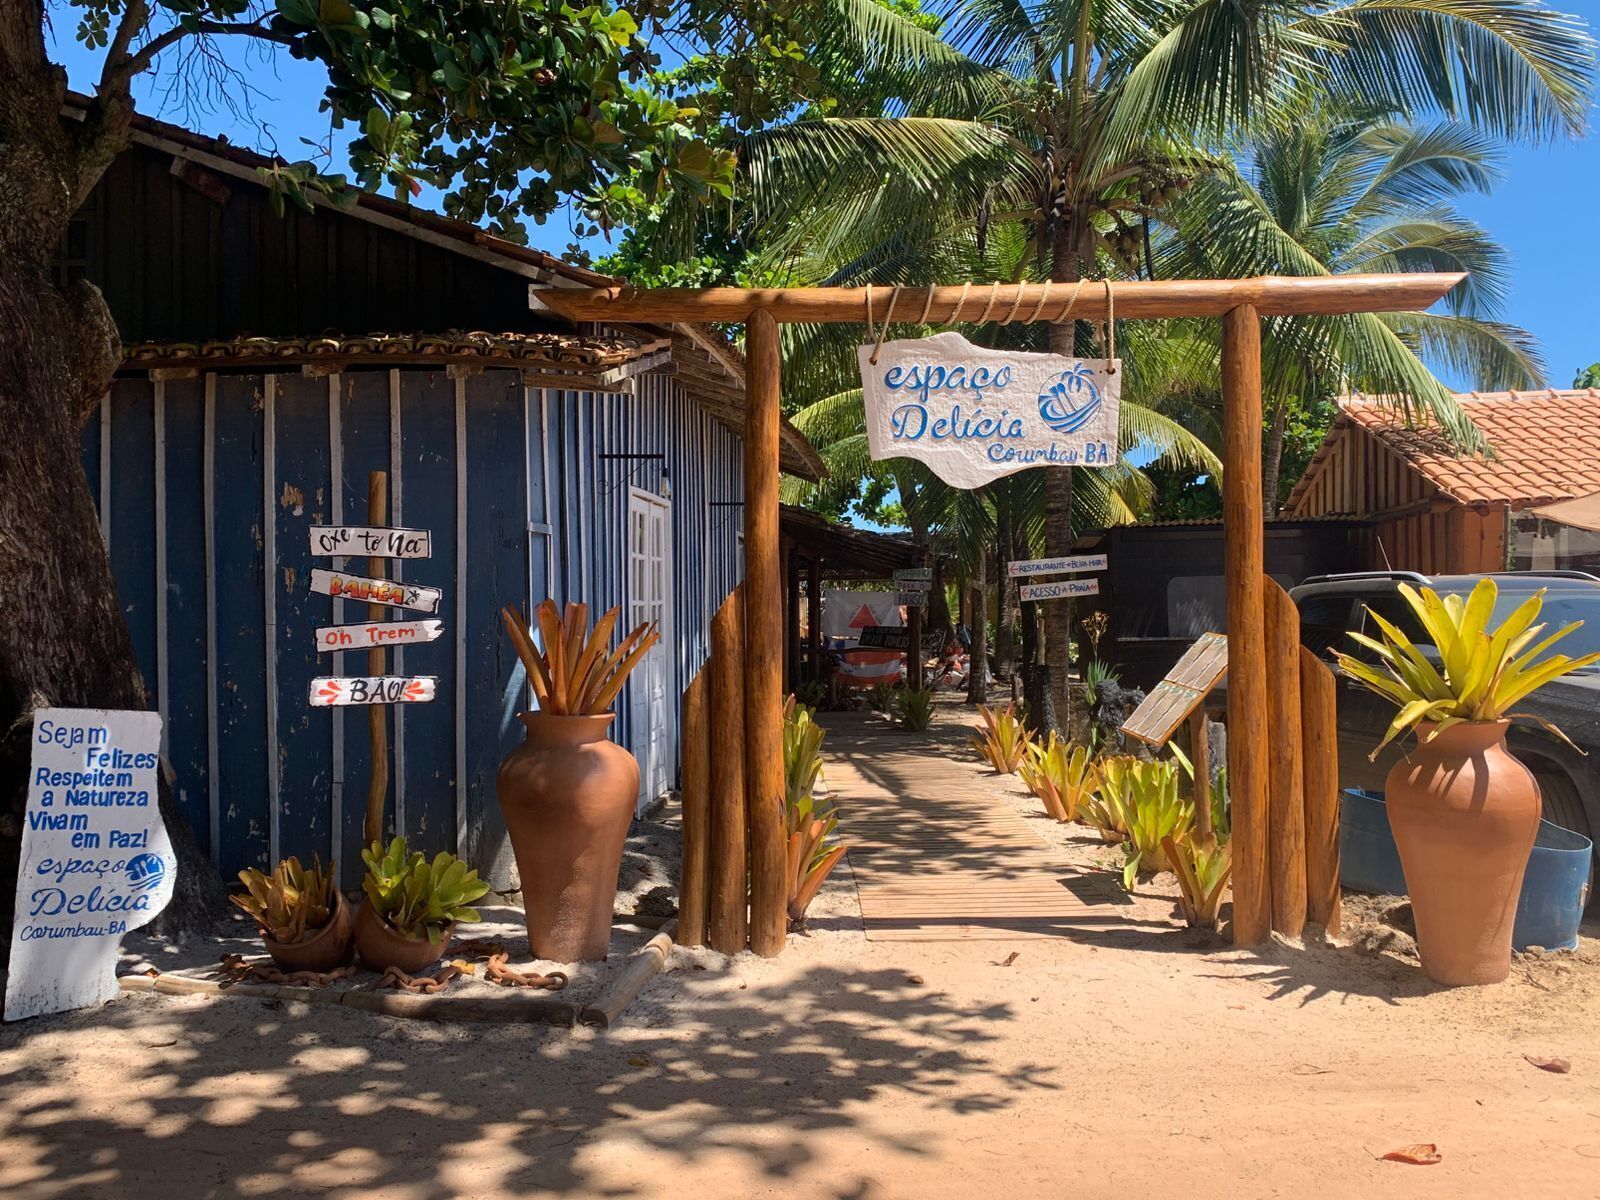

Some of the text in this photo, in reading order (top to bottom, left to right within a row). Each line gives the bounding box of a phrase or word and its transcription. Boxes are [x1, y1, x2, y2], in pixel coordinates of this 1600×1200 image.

[884, 363, 1015, 402] espaço
[892, 403, 1028, 440] Delícia
[319, 529, 351, 552] Oxe
[1028, 585, 1061, 598] ACESSO
[325, 626, 416, 645] Oh Trem
[38, 720, 107, 749] Sejam
[87, 748, 156, 769] Felizes
[36, 767, 133, 788] Respeitem
[41, 789, 149, 807] a Natureza
[28, 811, 88, 832] Vivam
[71, 829, 148, 849] em Paz!
[37, 857, 127, 884] espaço
[30, 886, 150, 917] Delícia
